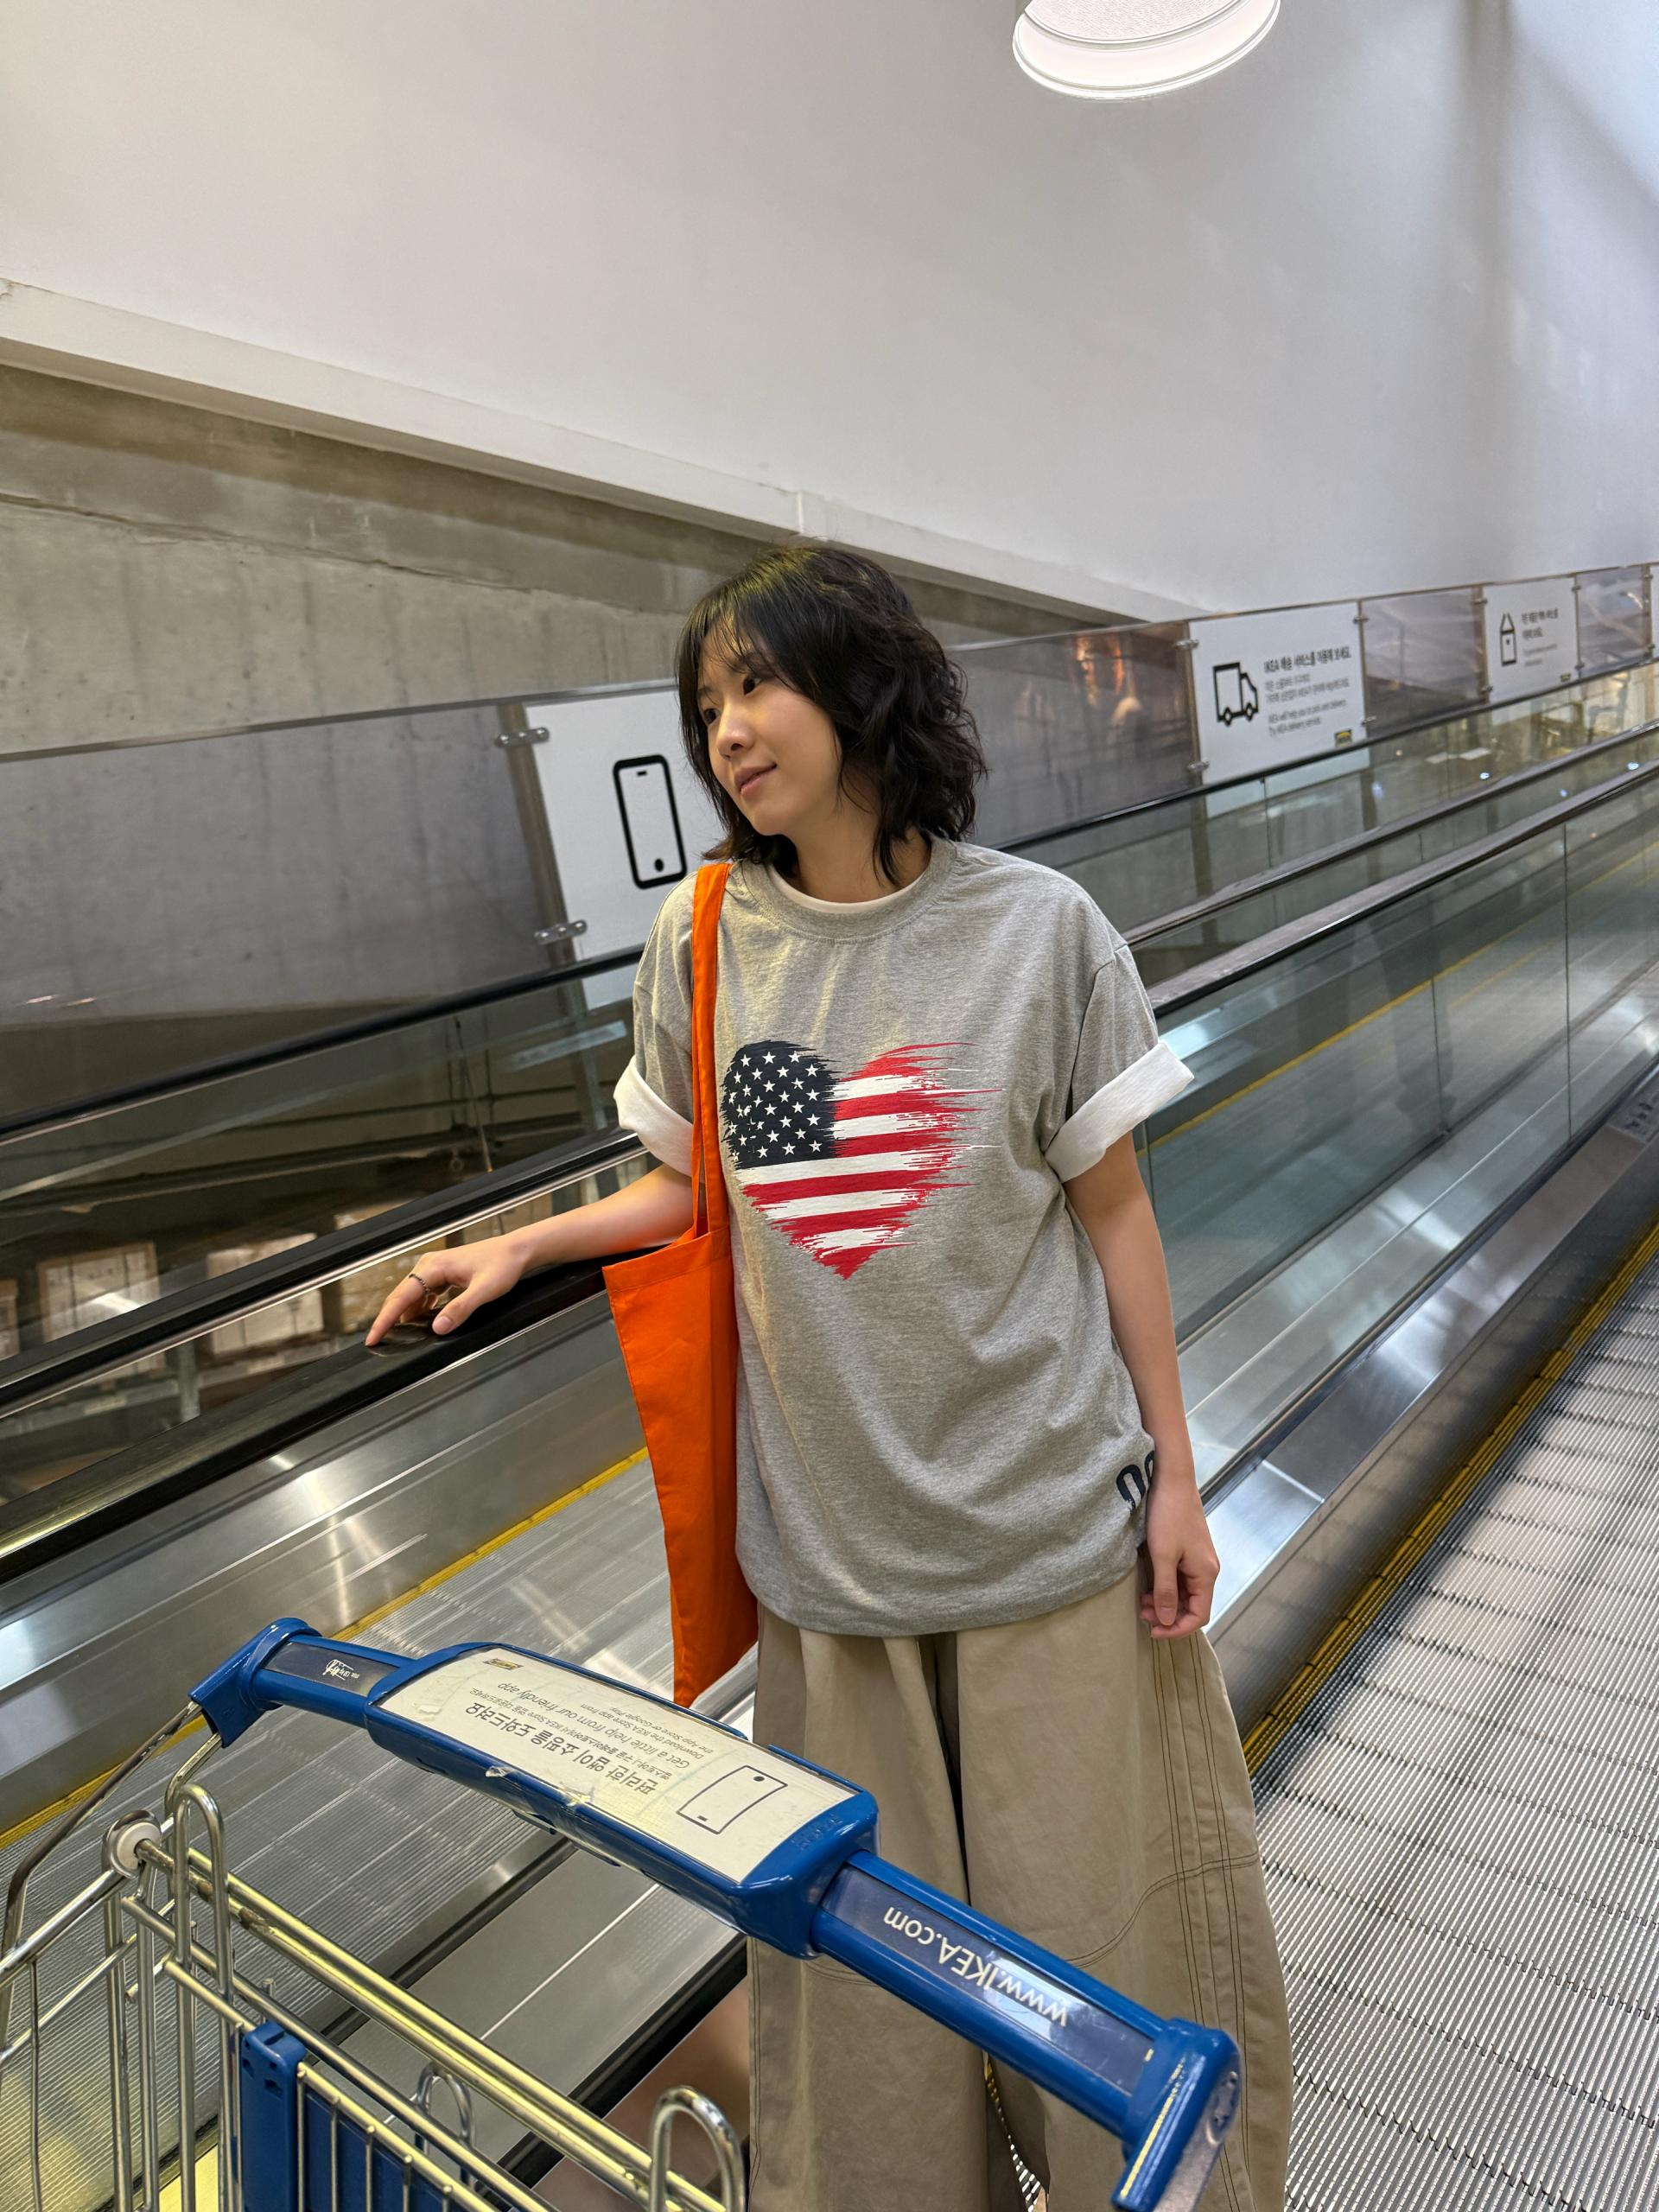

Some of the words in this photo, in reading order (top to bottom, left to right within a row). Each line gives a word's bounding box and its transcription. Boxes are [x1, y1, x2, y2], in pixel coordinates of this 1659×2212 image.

[498, 1683, 519, 1693] app
[517, 1690, 558, 1711] friendly
[555, 1708, 577, 1718] our
[581, 1704, 599, 1713] from
[466, 1703, 536, 1737] 도와드려요
[577, 1716, 606, 1732] from
[613, 1718, 633, 1728] Store
[605, 1729, 632, 1743] help
[632, 1726, 651, 1736] IKEA
[651, 1733, 664, 1742] the
[531, 1730, 580, 1755] 쇼핑을
[631, 1740, 658, 1755] little
[663, 1739, 704, 1759] Download
[573, 1750, 610, 1771] 앱이
[666, 1755, 690, 1768] Get
[606, 1765, 658, 1795] 편리한
[883, 1907, 1067, 2026] www.IKEA.com
